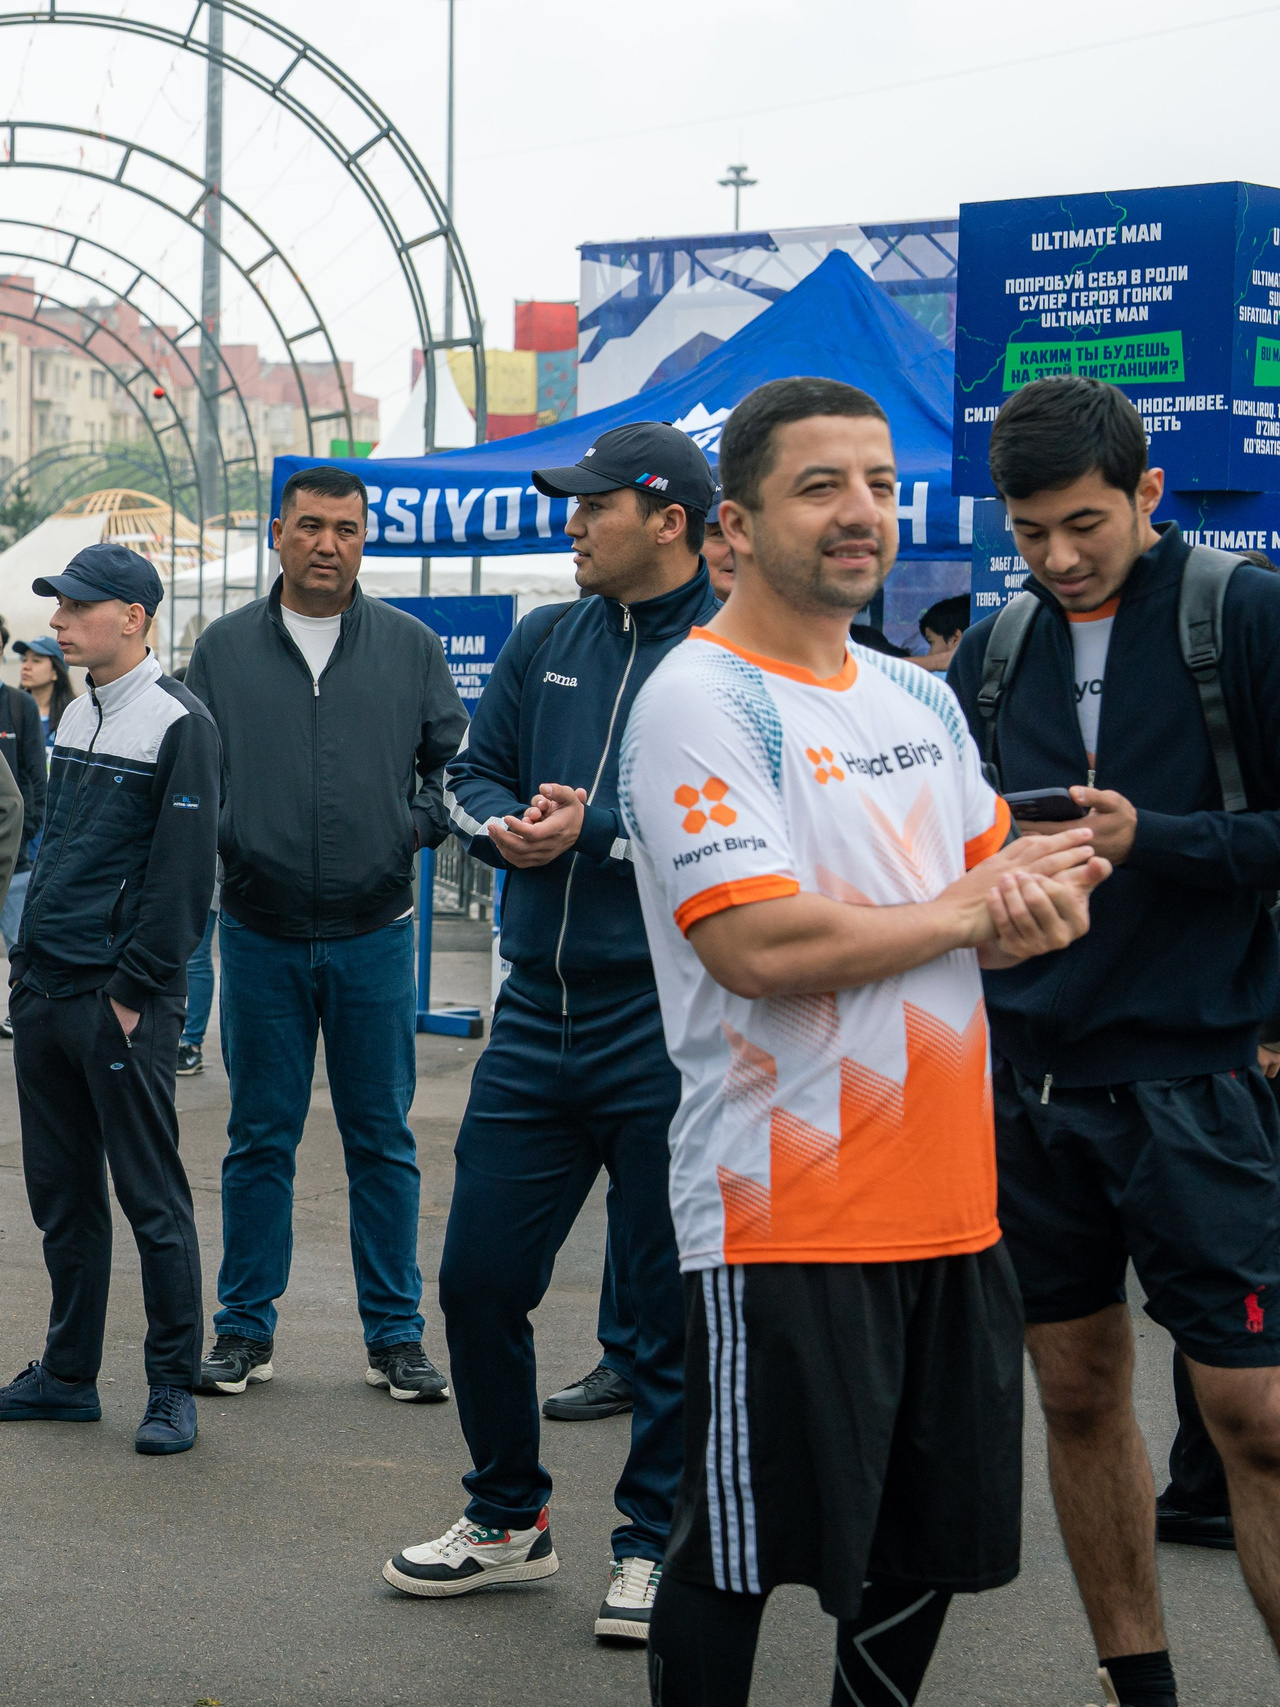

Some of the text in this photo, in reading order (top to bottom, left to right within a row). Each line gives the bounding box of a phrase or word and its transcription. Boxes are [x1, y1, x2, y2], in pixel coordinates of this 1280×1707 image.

[1031, 222, 1162, 251] ULTIMATE MAN
[1005, 265, 1188, 294] ПОПРОБУЙ СЕБЯ В РОЛИ
[1019, 284, 1173, 312] СУПЕР ГЕРОЯ ГОНКИ
[1041, 304, 1149, 328] ULTIMATE MAN
[1239, 305, 1272, 326] SIFATIDA
[1020, 342, 1170, 365] КАКИМ ТЫ БУДЕШЬ
[1011, 368, 1030, 383] НА
[1232, 398, 1276, 419] KUCHLIROQ.
[1142, 416, 1182, 433] ДЕТЬ
[990, 556, 1012, 572] ЗАБЕГ
[975, 592, 1001, 607] ТЕПЕРЬ
[451, 635, 486, 655] MAN
[840, 738, 944, 780] Hayot Birja
[672, 835, 767, 871] Hayot Birja
